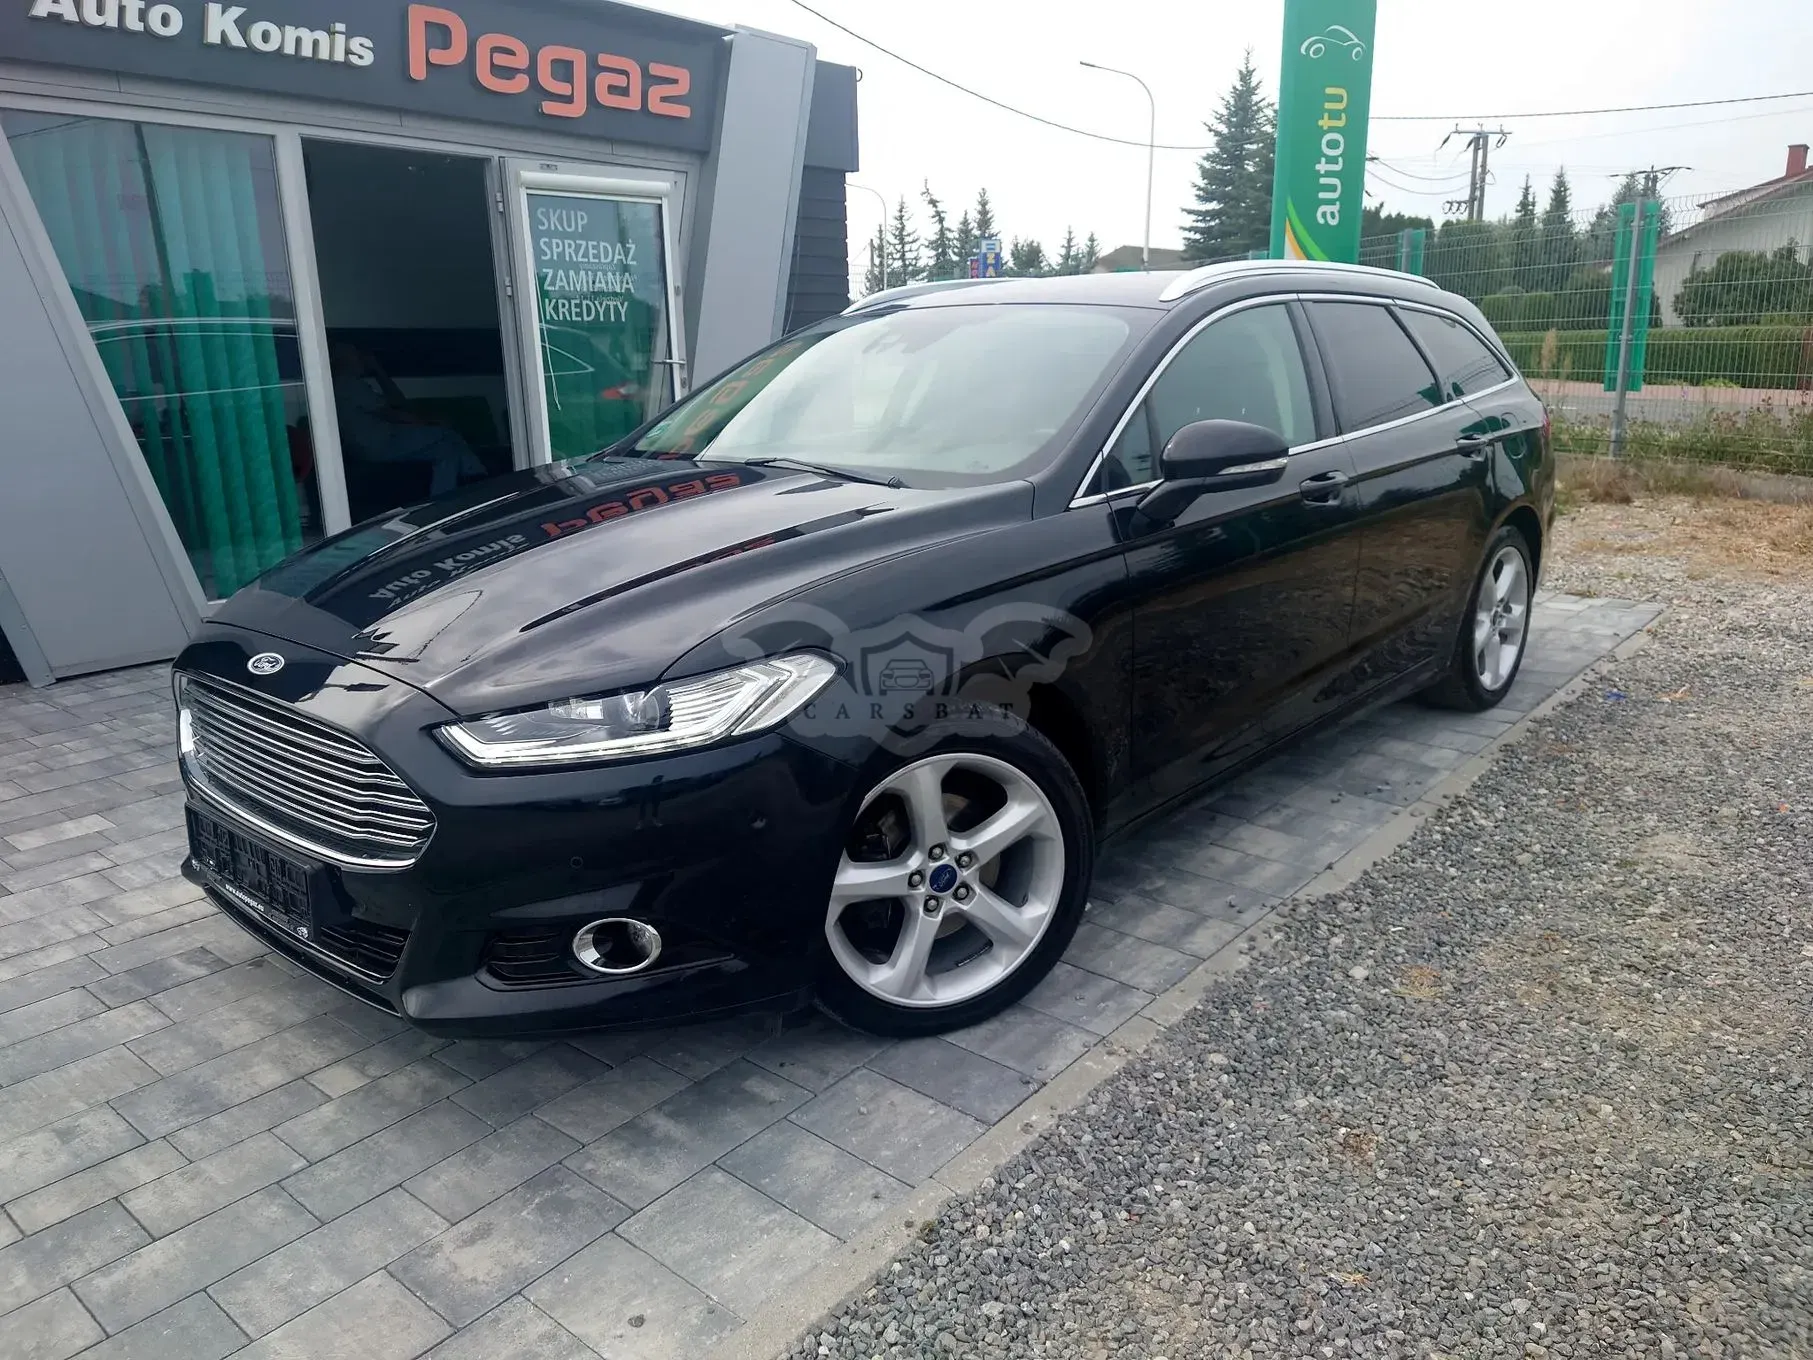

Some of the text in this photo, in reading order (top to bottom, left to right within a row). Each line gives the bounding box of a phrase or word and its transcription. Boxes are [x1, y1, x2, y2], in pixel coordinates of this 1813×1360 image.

[28, 0, 691, 118] Auto Komis Pegaz
[1315, 87, 1348, 226] autotu
[537, 207, 588, 232] SKUP
[539, 238, 637, 265] SPRZEDAŻ
[542, 268, 635, 293] ZAMIANA
[544, 298, 628, 322] KREDYTY
